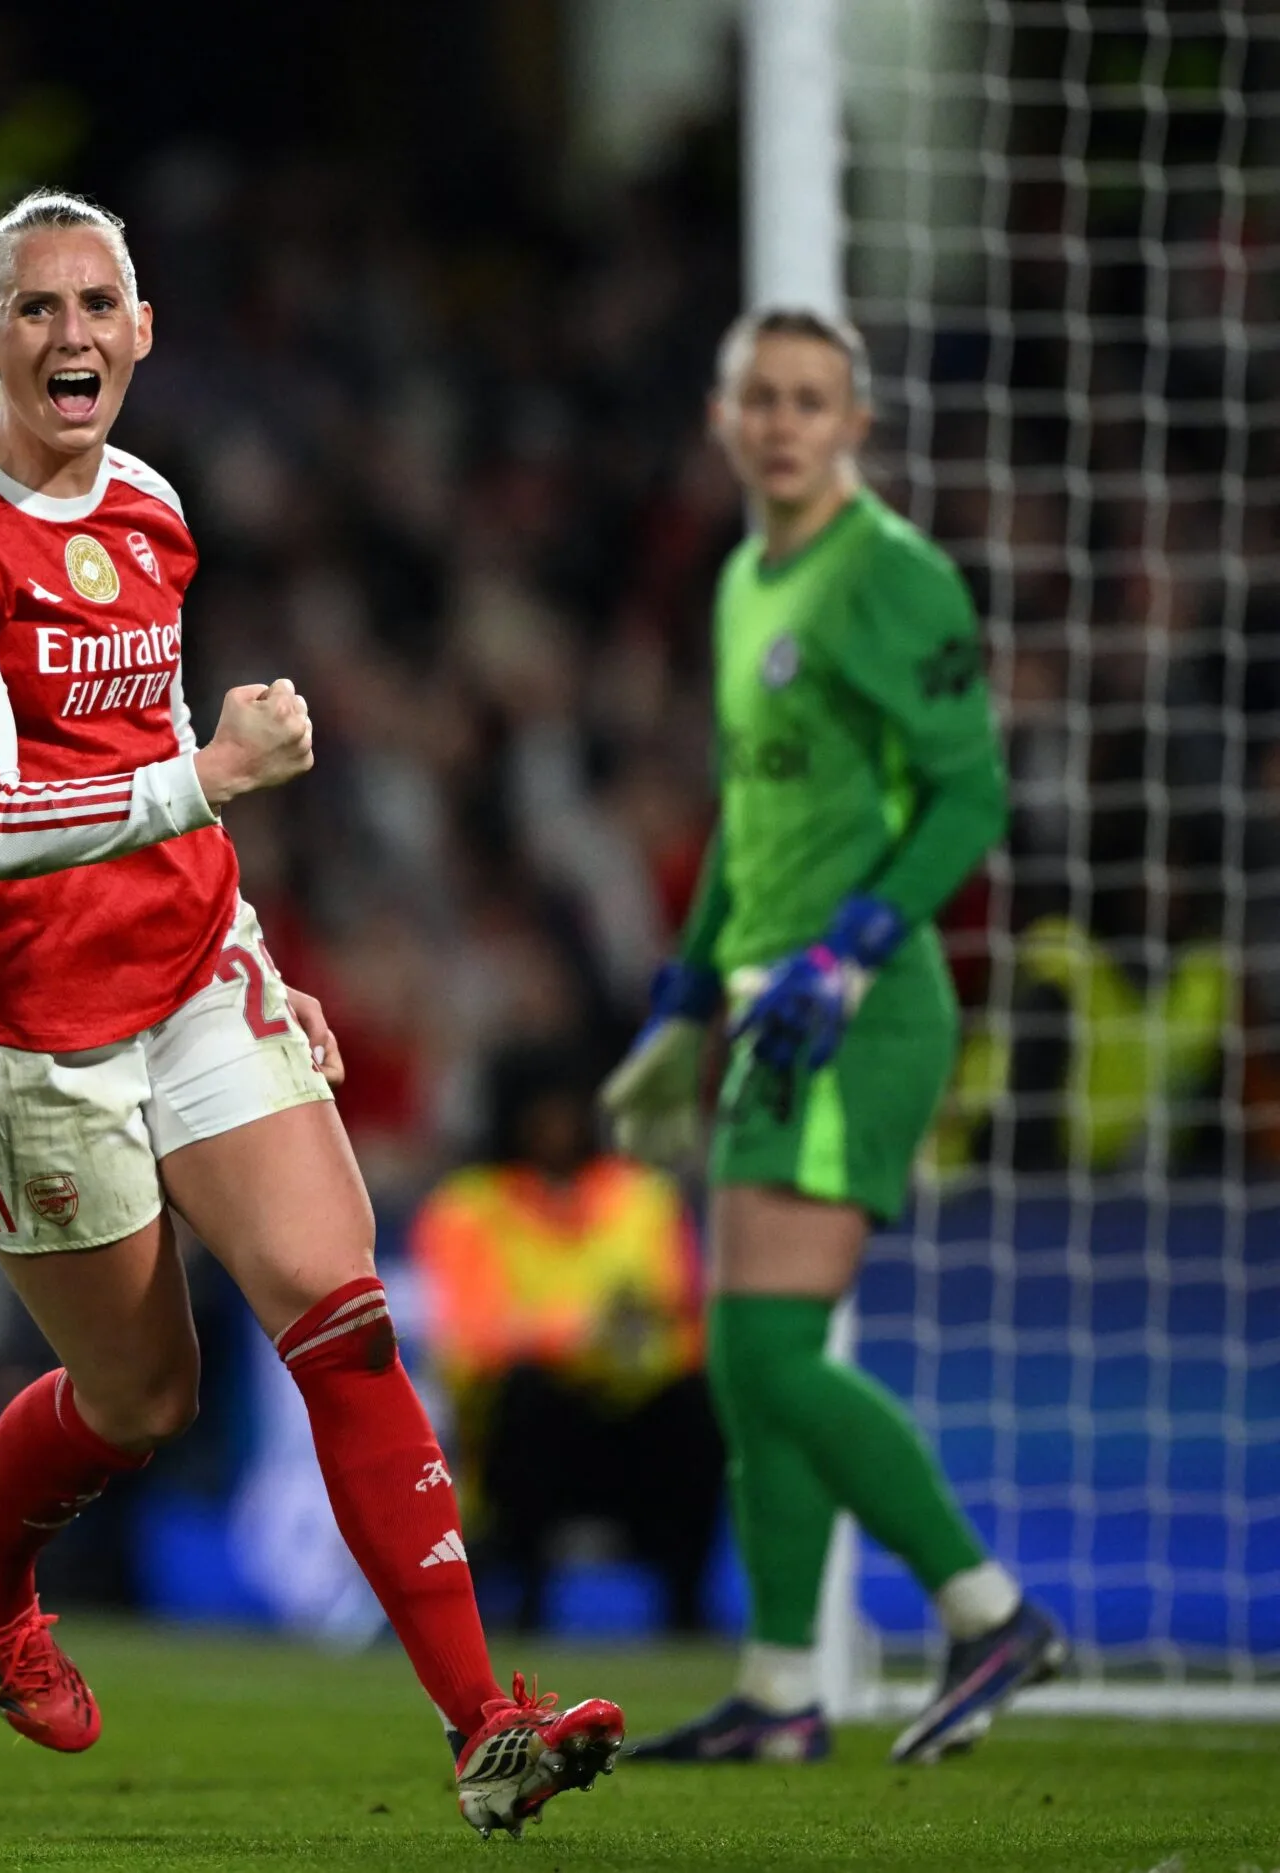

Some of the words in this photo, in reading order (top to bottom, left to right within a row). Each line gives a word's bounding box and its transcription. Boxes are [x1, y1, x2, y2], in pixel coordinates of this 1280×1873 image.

[36, 620, 181, 674] Emirates
[61, 679, 104, 718] FLY
[101, 670, 171, 710] BETTER
[214, 938, 299, 1041] 2
